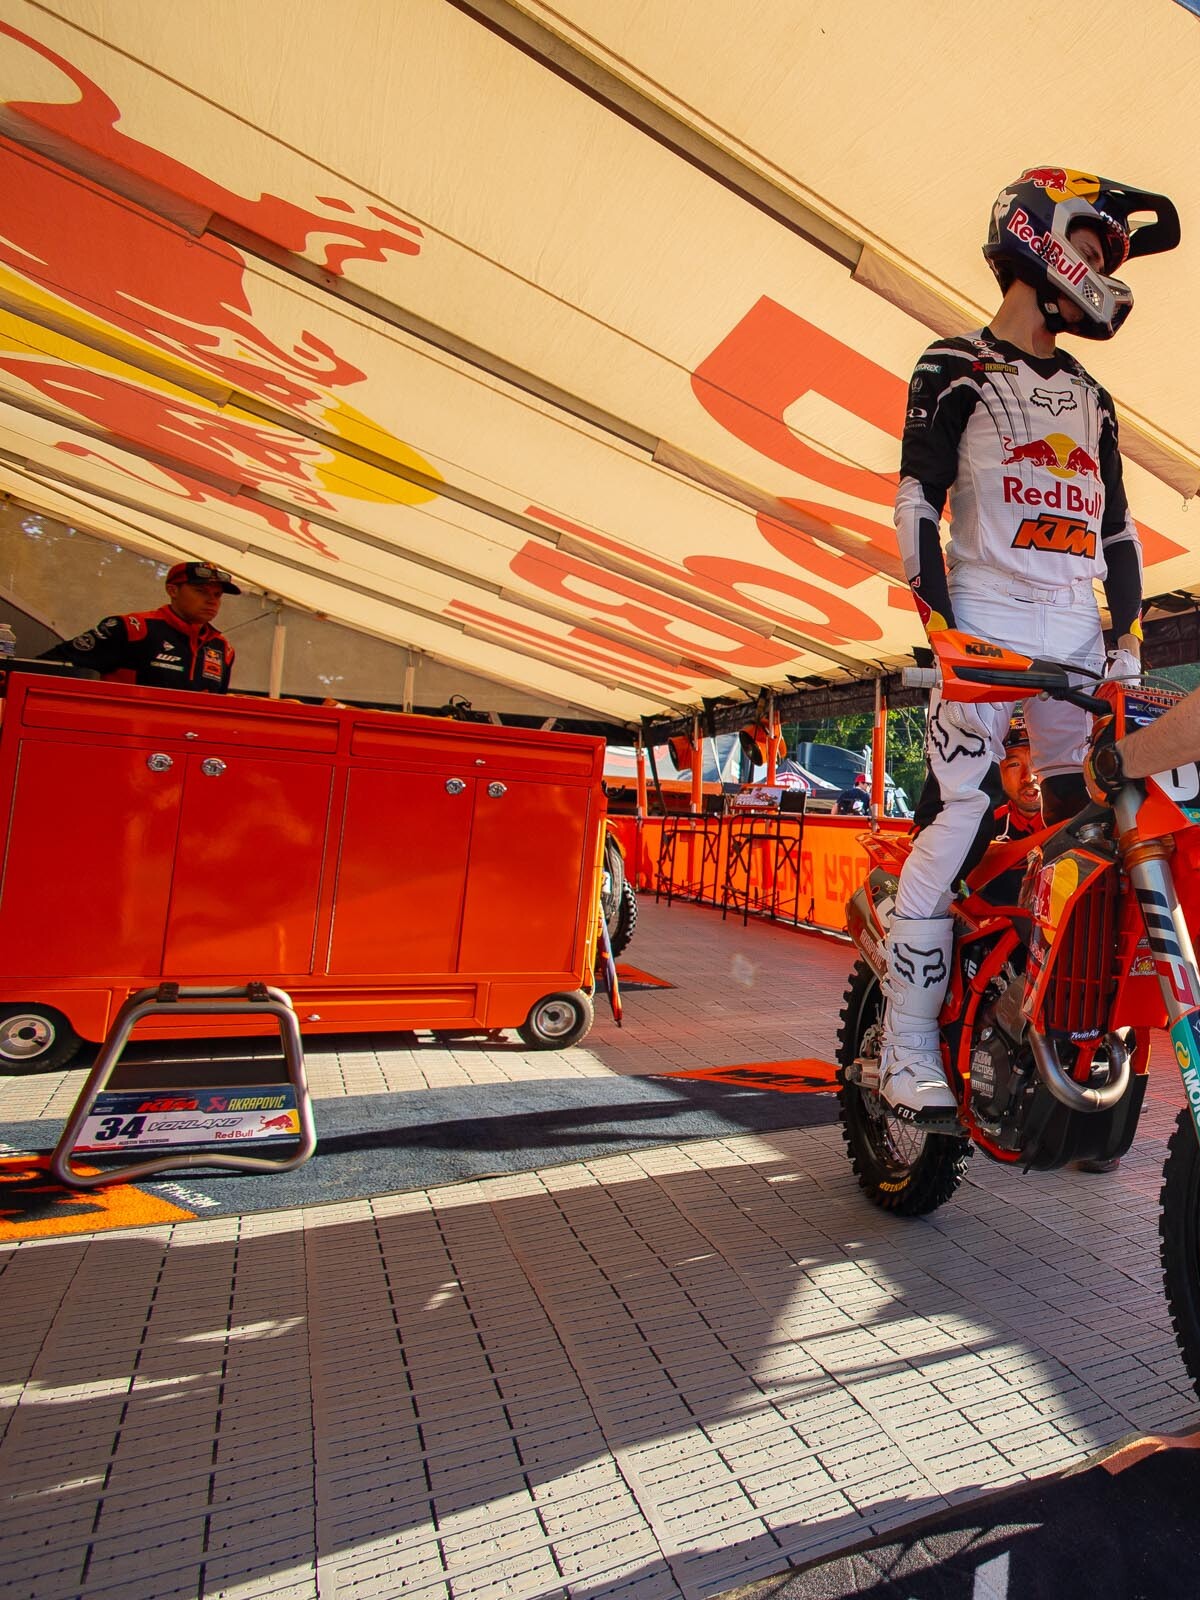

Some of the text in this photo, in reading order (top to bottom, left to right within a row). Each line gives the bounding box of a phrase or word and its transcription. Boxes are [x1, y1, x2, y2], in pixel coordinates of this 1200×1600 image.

[1007, 208, 1052, 257] Red
[1043, 239, 1089, 286] Bull
[1003, 476, 1101, 520] Red Bull
[1011, 512, 1096, 560] KTM
[965, 642, 1004, 658] KTM
[1135, 888, 1196, 1006] WP
[1070, 1028, 1100, 1040] Twin Air
[897, 1107, 918, 1121] FOX
[95, 1115, 244, 1141] 34 VOHLAND
[215, 1129, 253, 1139] Red Bull
